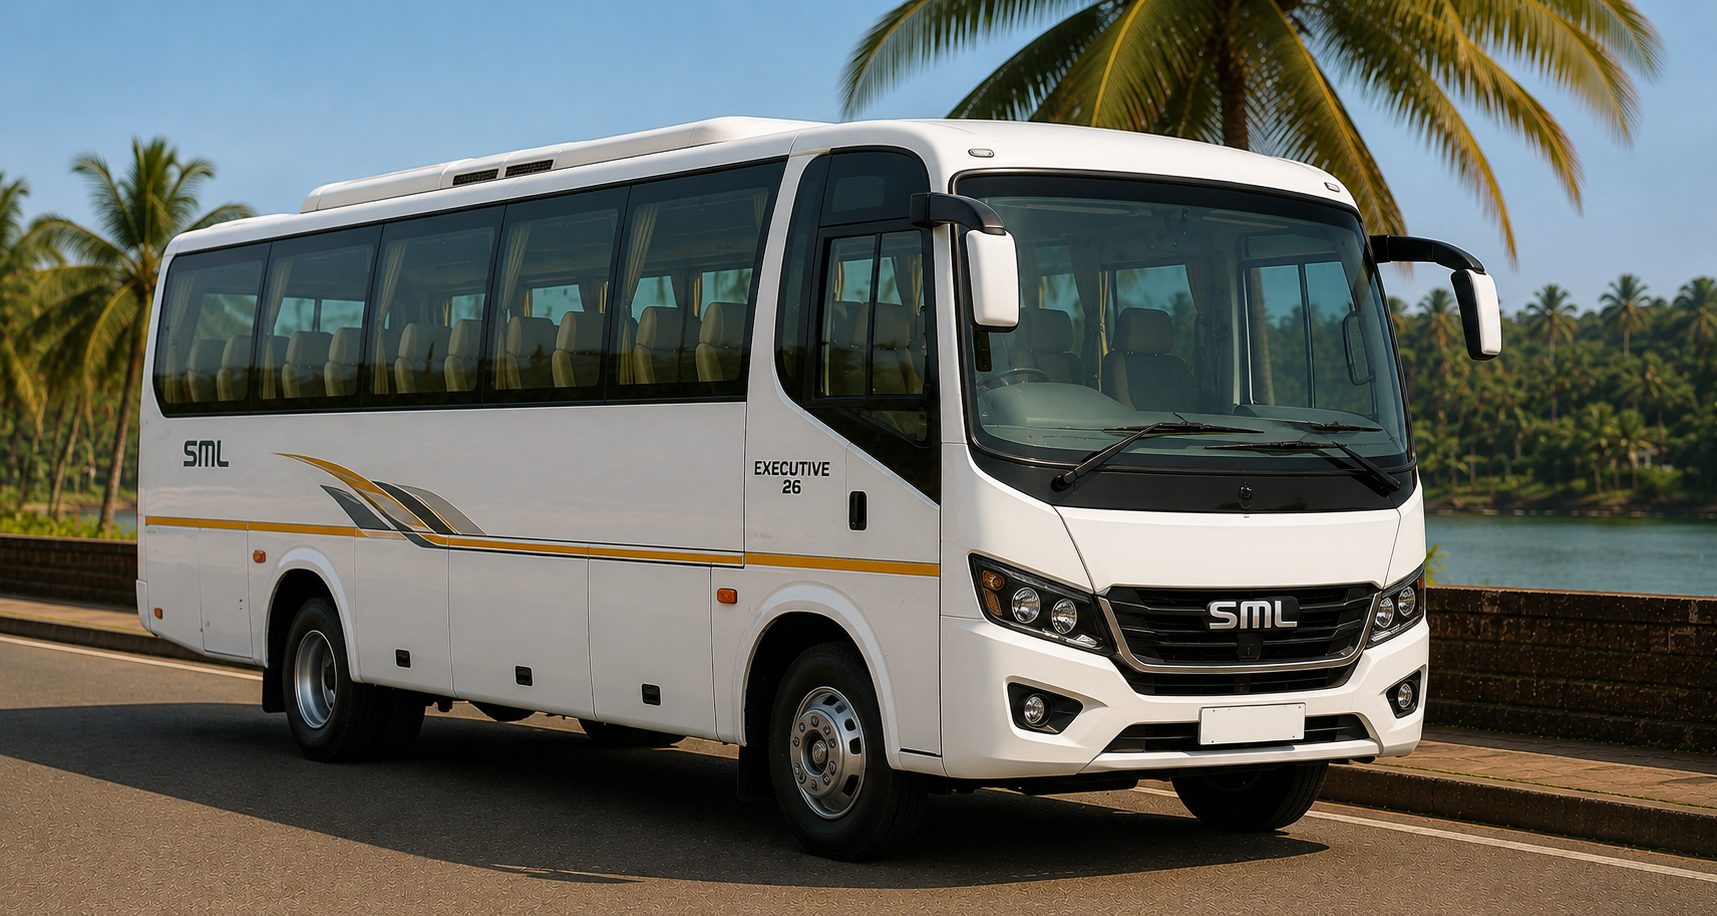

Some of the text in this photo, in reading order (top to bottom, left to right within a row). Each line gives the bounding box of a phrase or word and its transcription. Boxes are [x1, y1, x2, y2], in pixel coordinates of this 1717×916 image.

[183, 439, 230, 468] SML
[754, 460, 831, 477] EXECUTIVE
[781, 479, 802, 495] 26
[1208, 600, 1298, 630] SML
